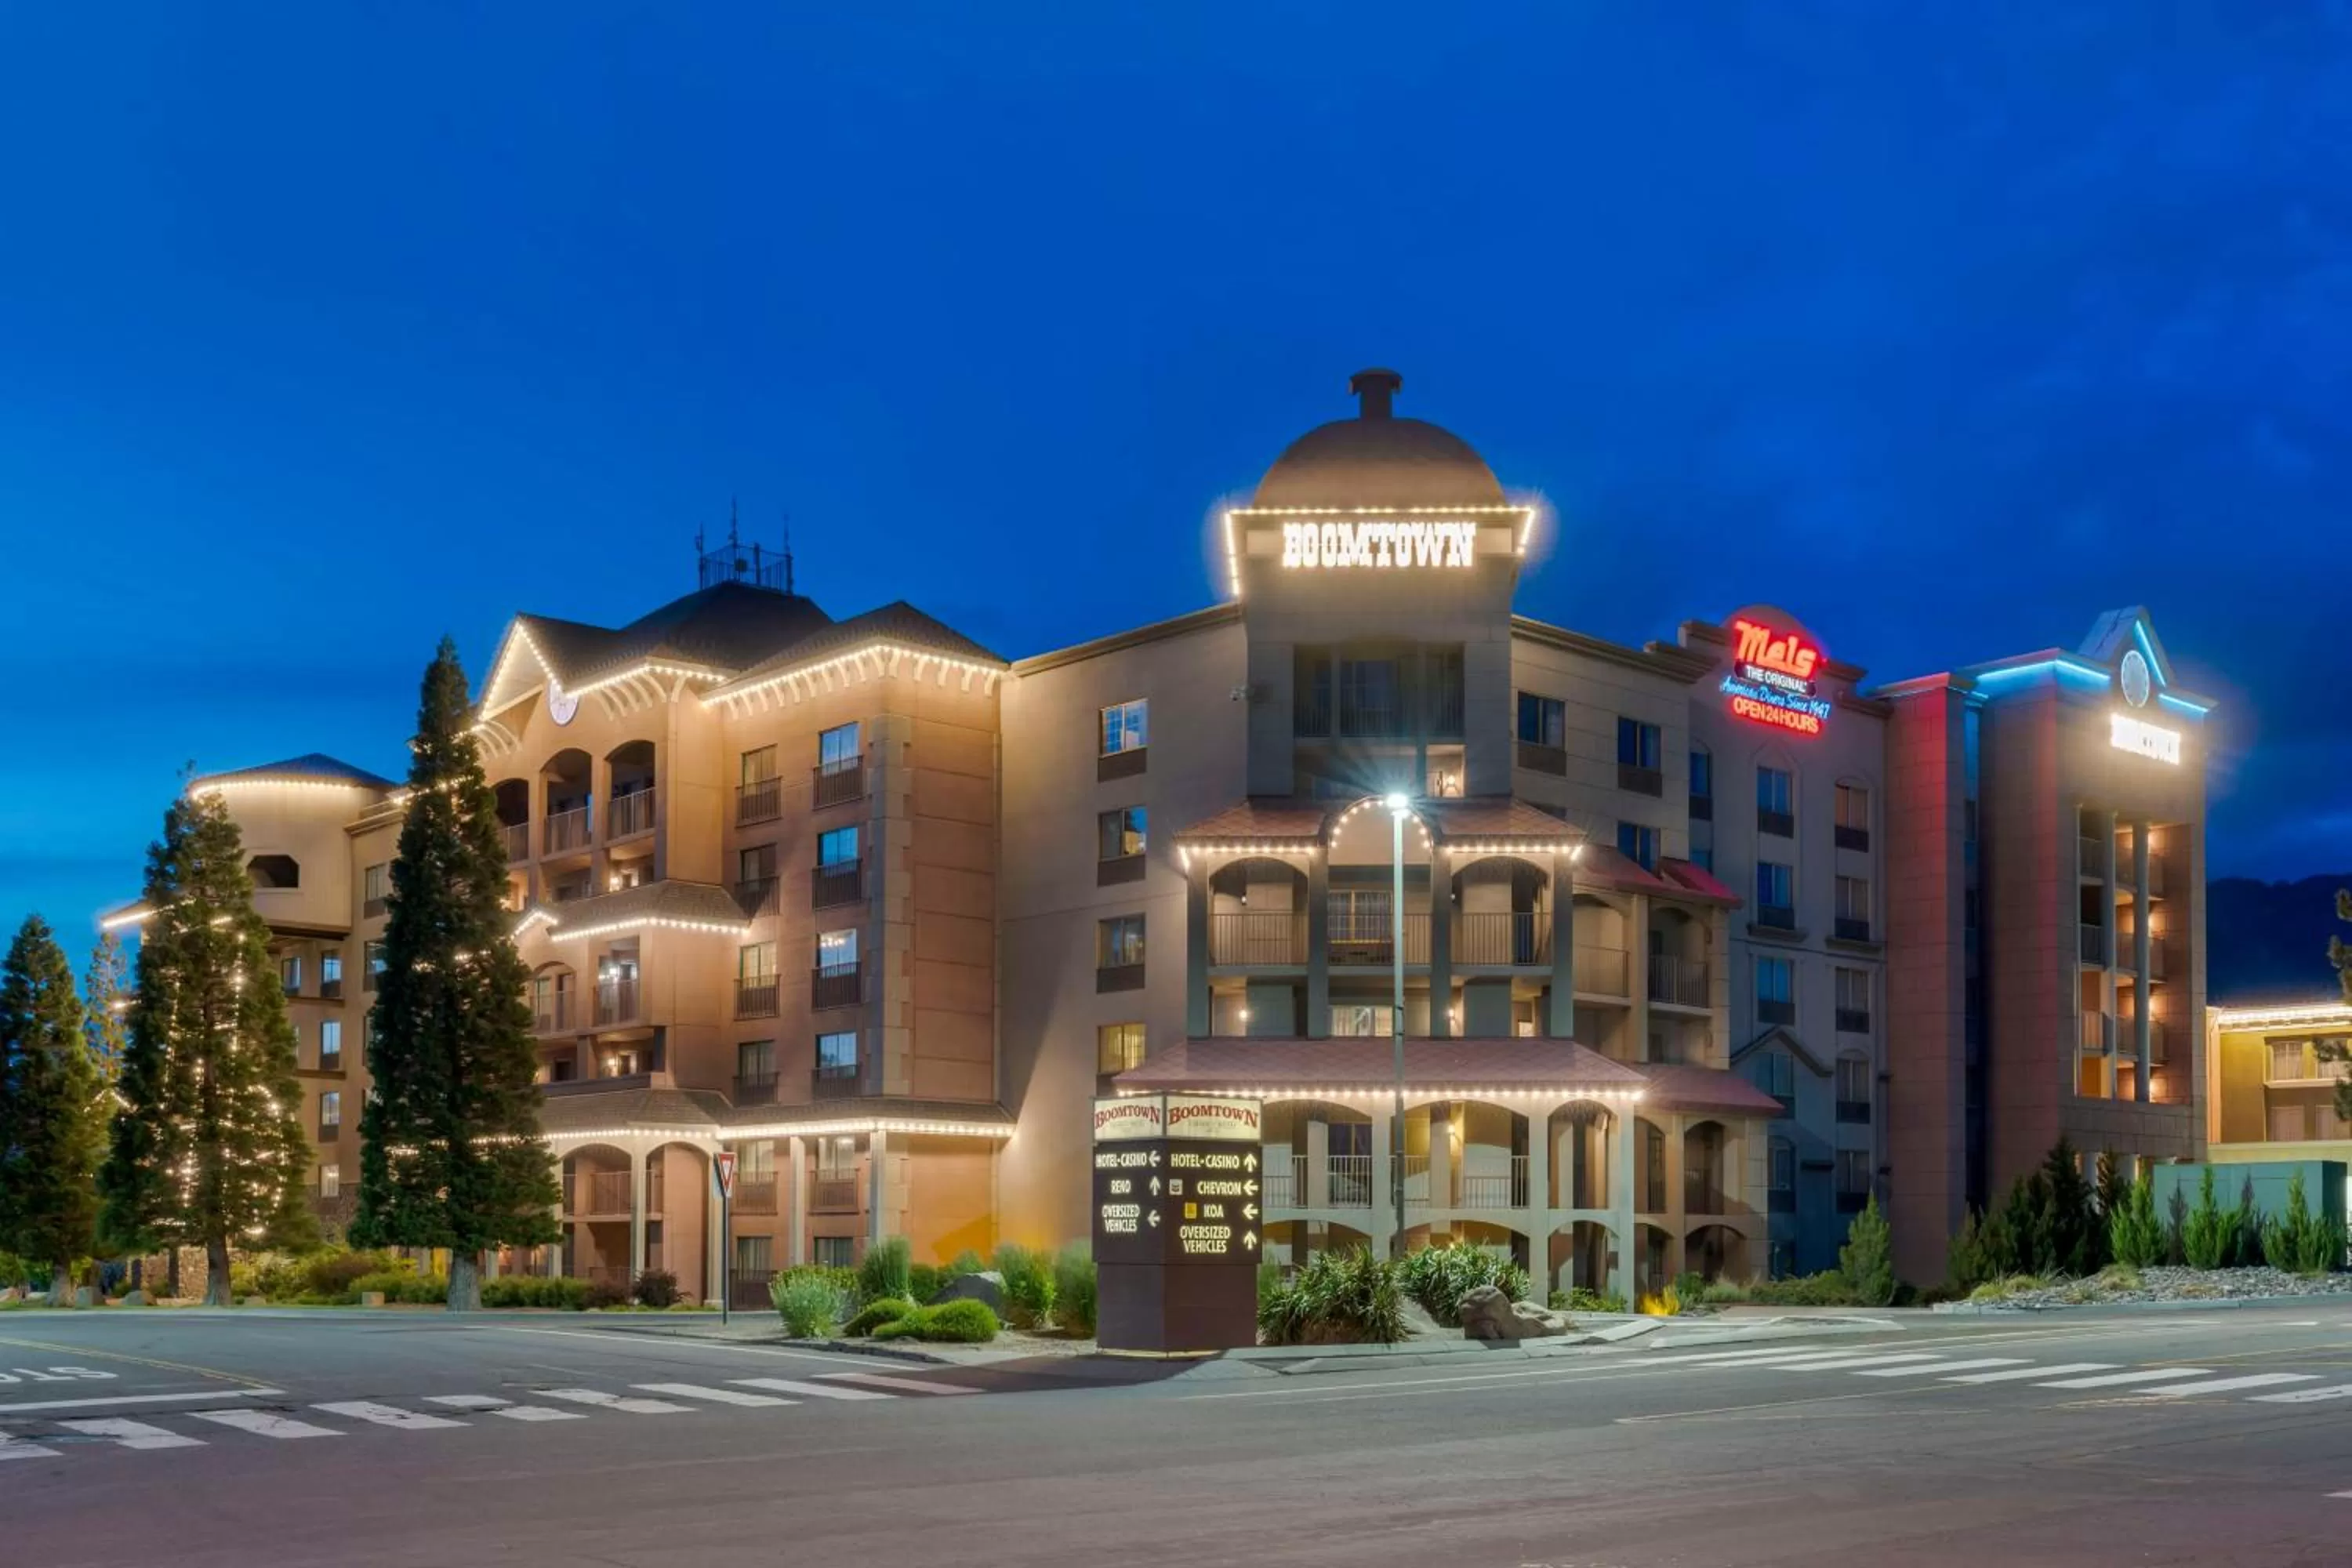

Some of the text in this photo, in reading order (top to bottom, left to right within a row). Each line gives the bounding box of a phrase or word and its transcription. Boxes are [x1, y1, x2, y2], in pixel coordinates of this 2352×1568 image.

[1282, 522, 1475, 567] BOOMTOWN
[1735, 620, 1817, 677] Mels
[1746, 664, 1764, 682] THE
[1733, 696, 1820, 734] OPEN 24 HOURS
[1095, 1104, 1160, 1130] BOOMTOWN
[1168, 1104, 1258, 1129] BOOMTOWN
[1111, 1179, 1131, 1194] RENO
[1196, 1181, 1241, 1195] CHEVRON
[1102, 1203, 1140, 1218] OVERSIZED
[1203, 1203, 1224, 1218] KOA
[1104, 1218, 1137, 1232] VEHICLES
[1179, 1225, 1231, 1240] OVERSIZED
[1183, 1240, 1227, 1254] VEHICLES
